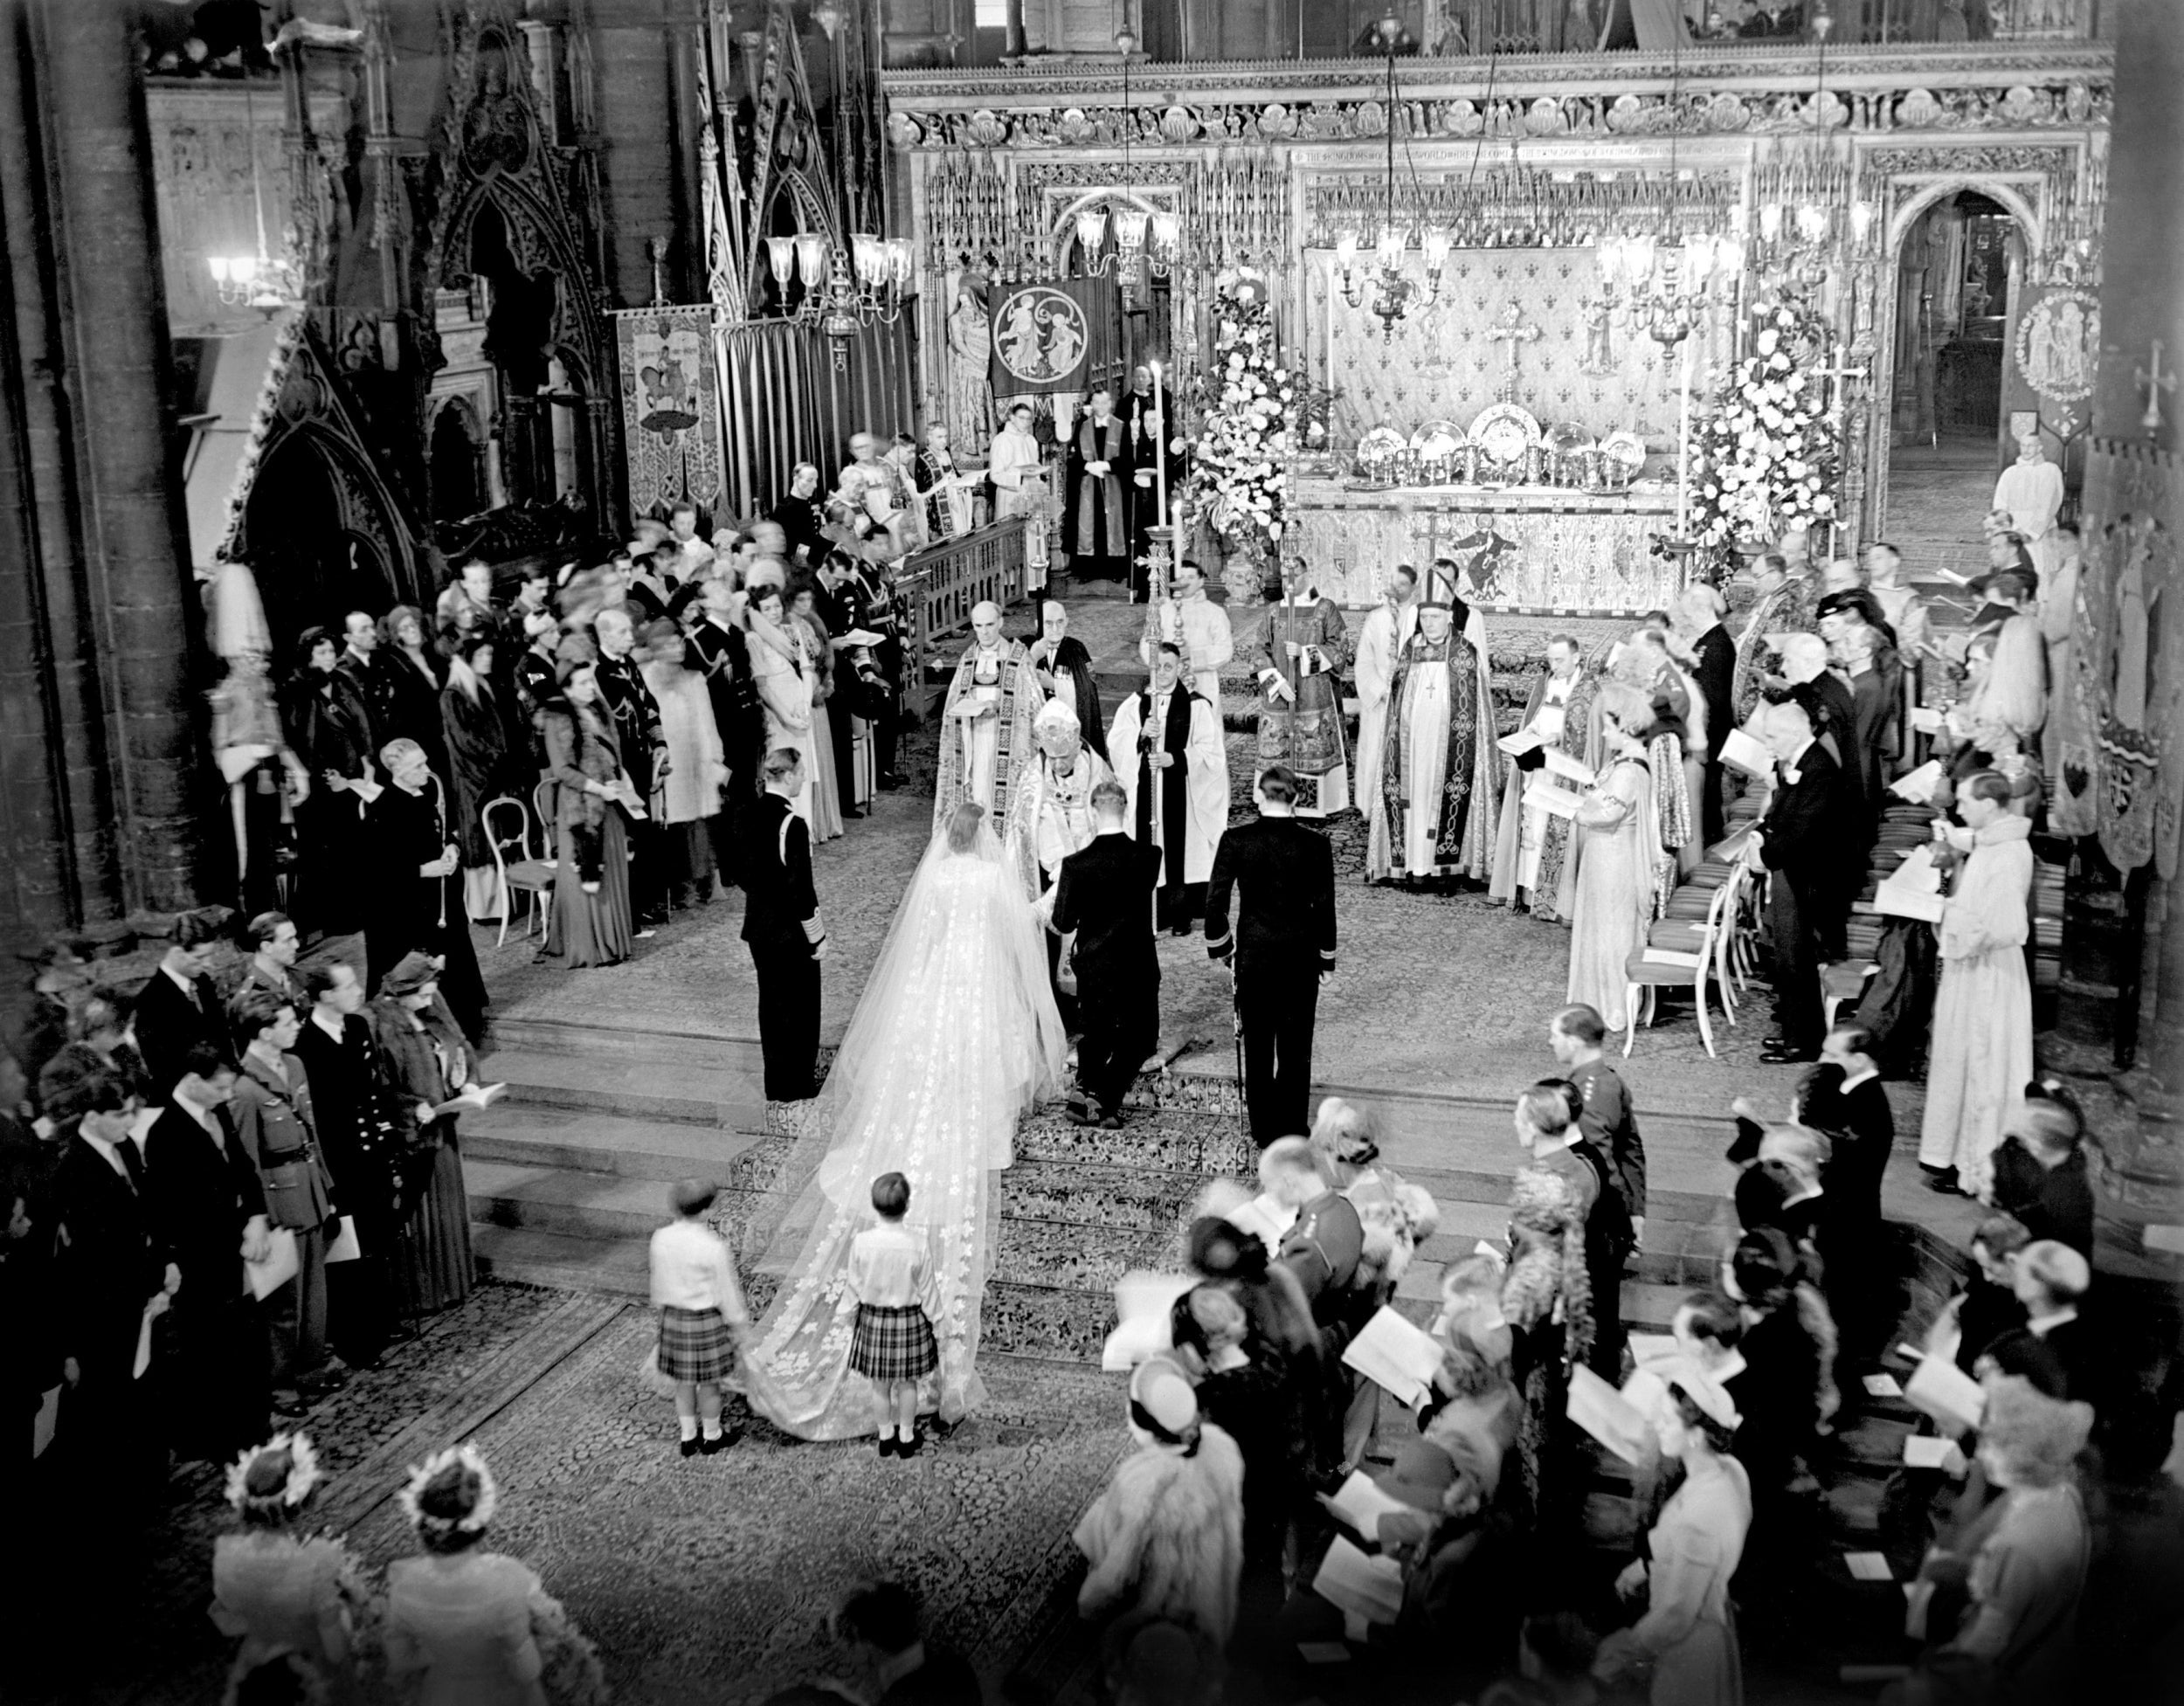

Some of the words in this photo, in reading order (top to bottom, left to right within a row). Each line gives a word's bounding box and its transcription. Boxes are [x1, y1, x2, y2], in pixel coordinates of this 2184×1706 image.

[1305, 153, 1319, 162] THE
[1327, 152, 1369, 162] KINGDOMS
[1419, 151, 1447, 160] WORLD
